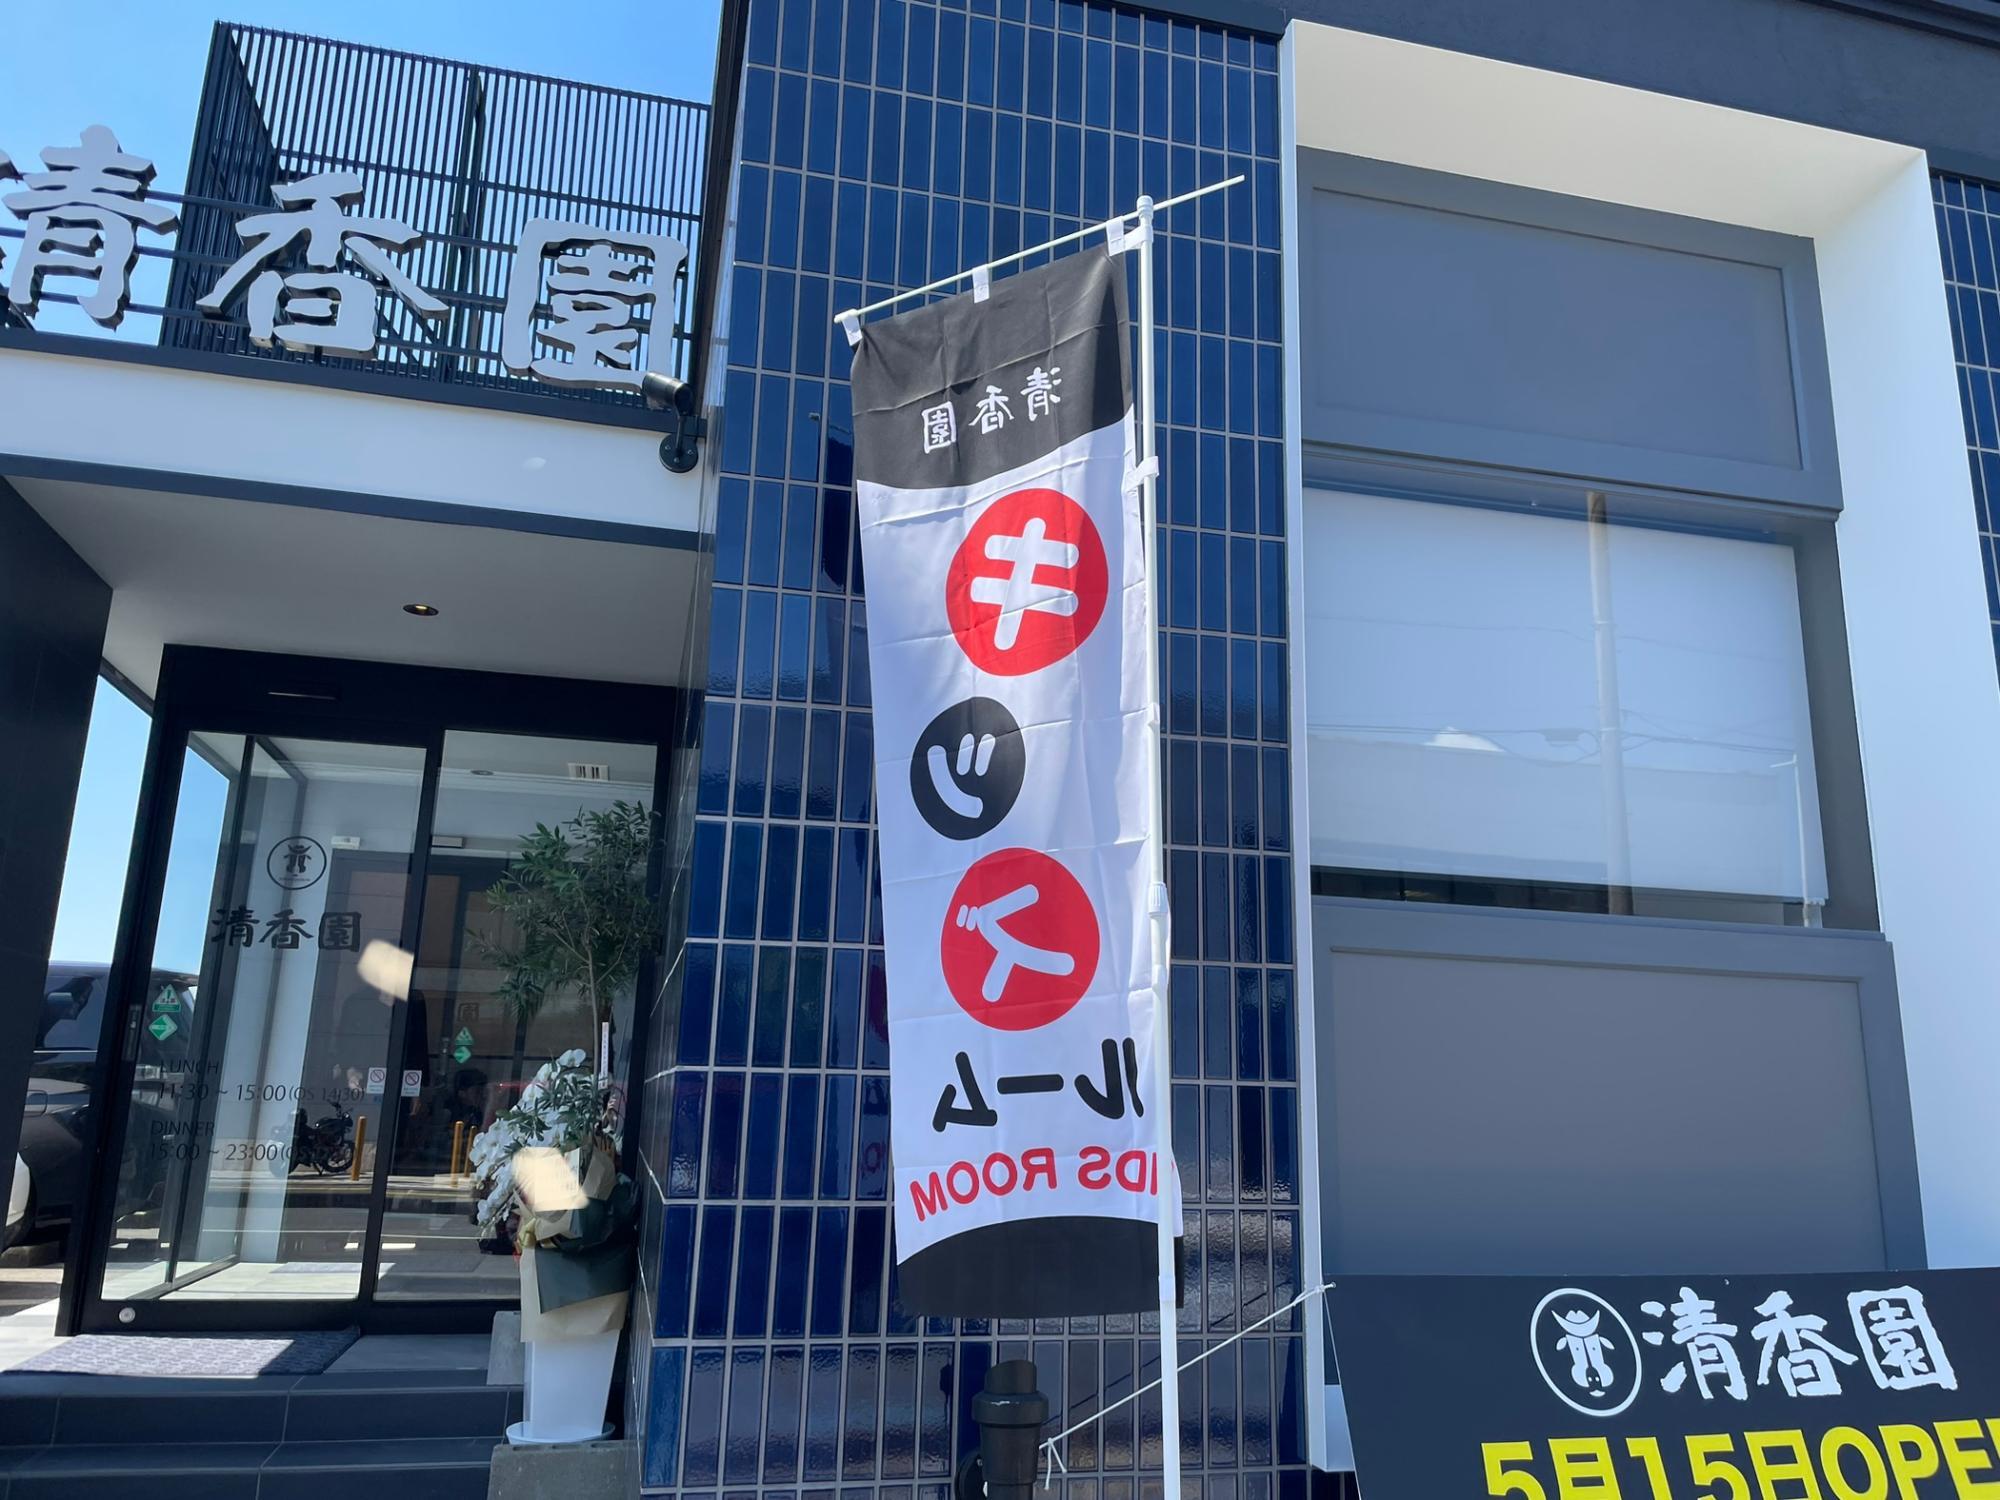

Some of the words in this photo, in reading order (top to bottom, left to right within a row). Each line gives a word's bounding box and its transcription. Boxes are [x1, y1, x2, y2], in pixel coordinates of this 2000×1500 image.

[211, 904, 362, 953] 清香園
[1640, 1286, 1957, 1400] 清香園
[1481, 1418, 2000, 1500] 5月15日OPE
